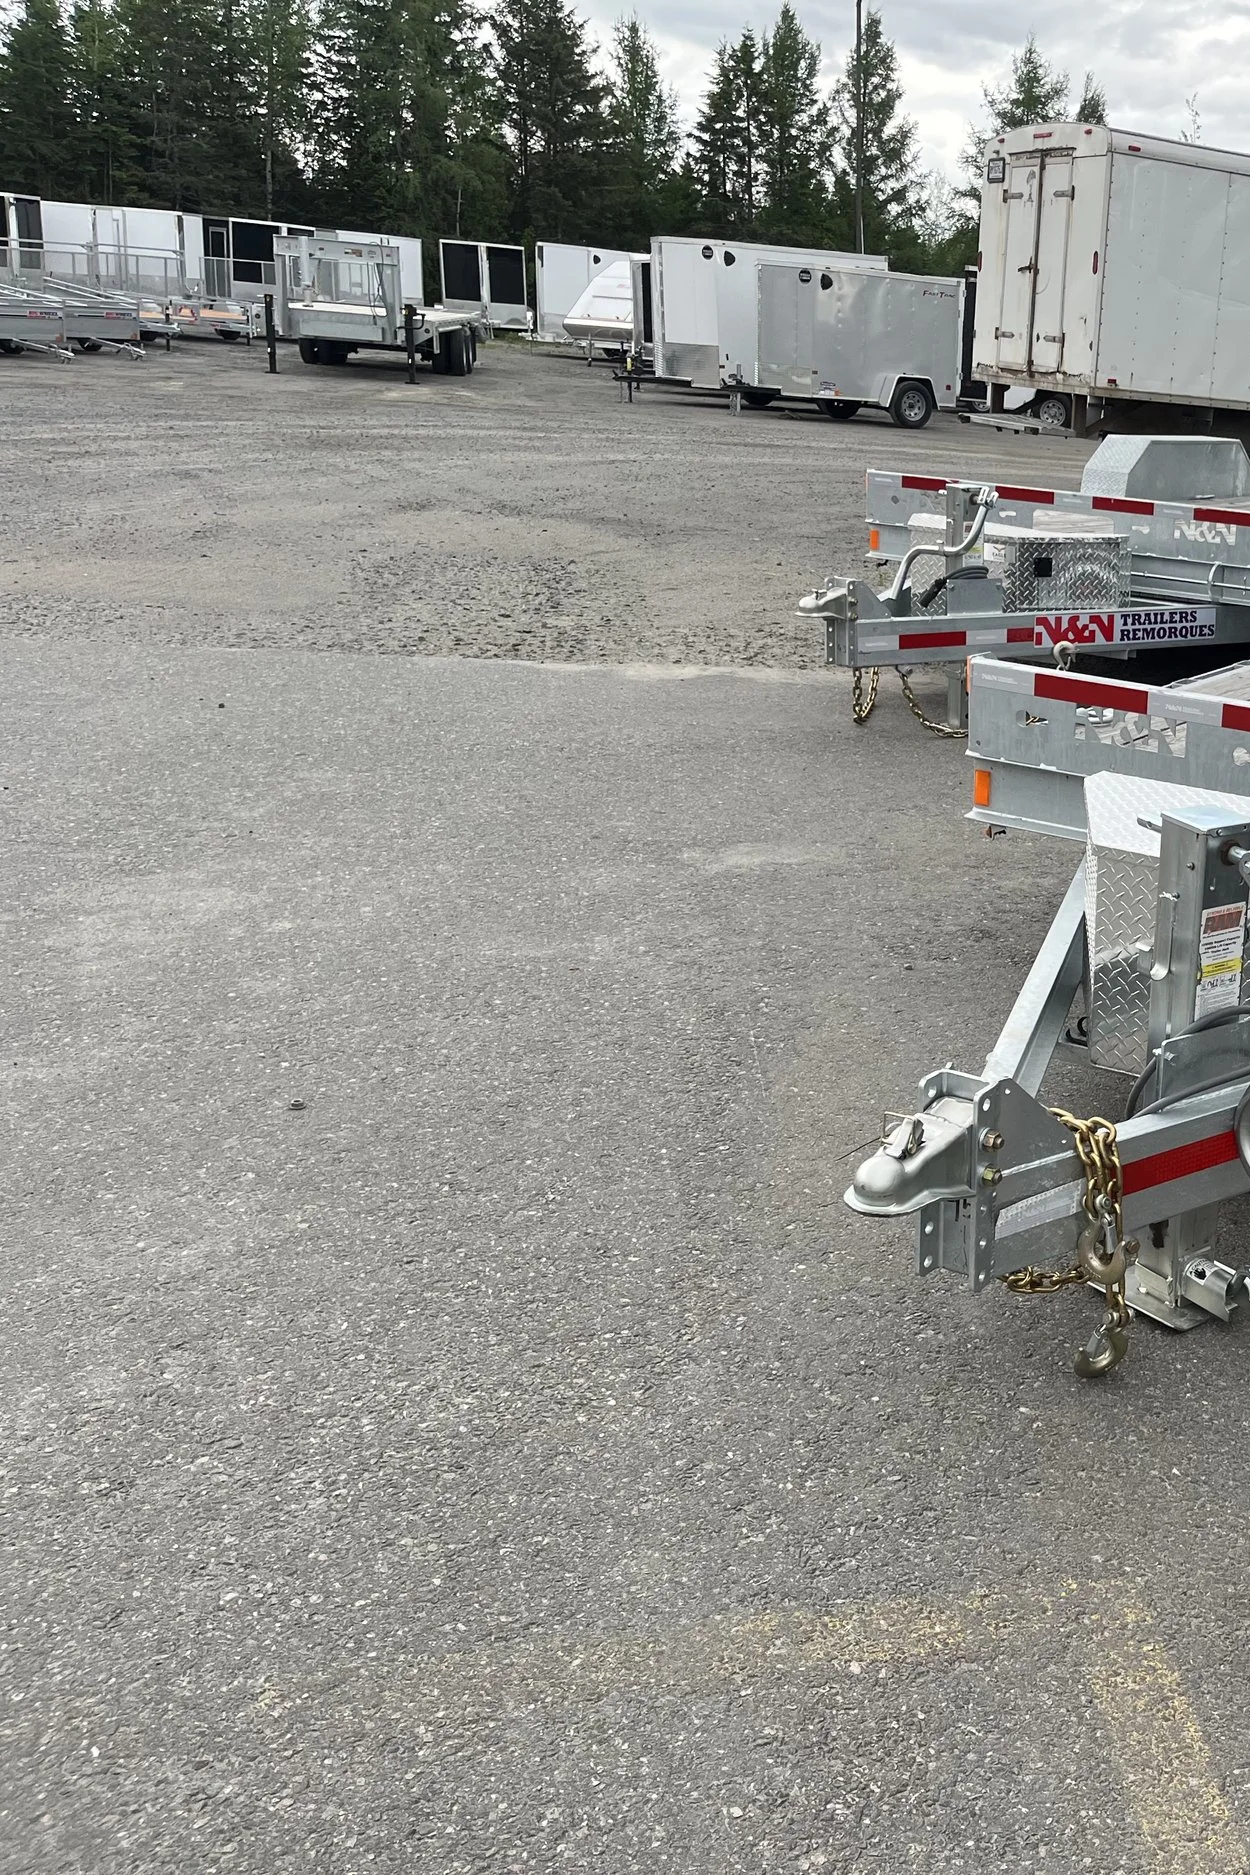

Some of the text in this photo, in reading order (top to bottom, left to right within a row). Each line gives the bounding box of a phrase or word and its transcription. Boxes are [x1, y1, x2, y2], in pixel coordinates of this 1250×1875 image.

[1173, 519, 1237, 546] N&N
[1034, 614, 1115, 646] N&N
[1120, 610, 1198, 627] TRAILERS
[1119, 624, 1215, 642] REMORQUES
[1074, 703, 1188, 759] N&N
